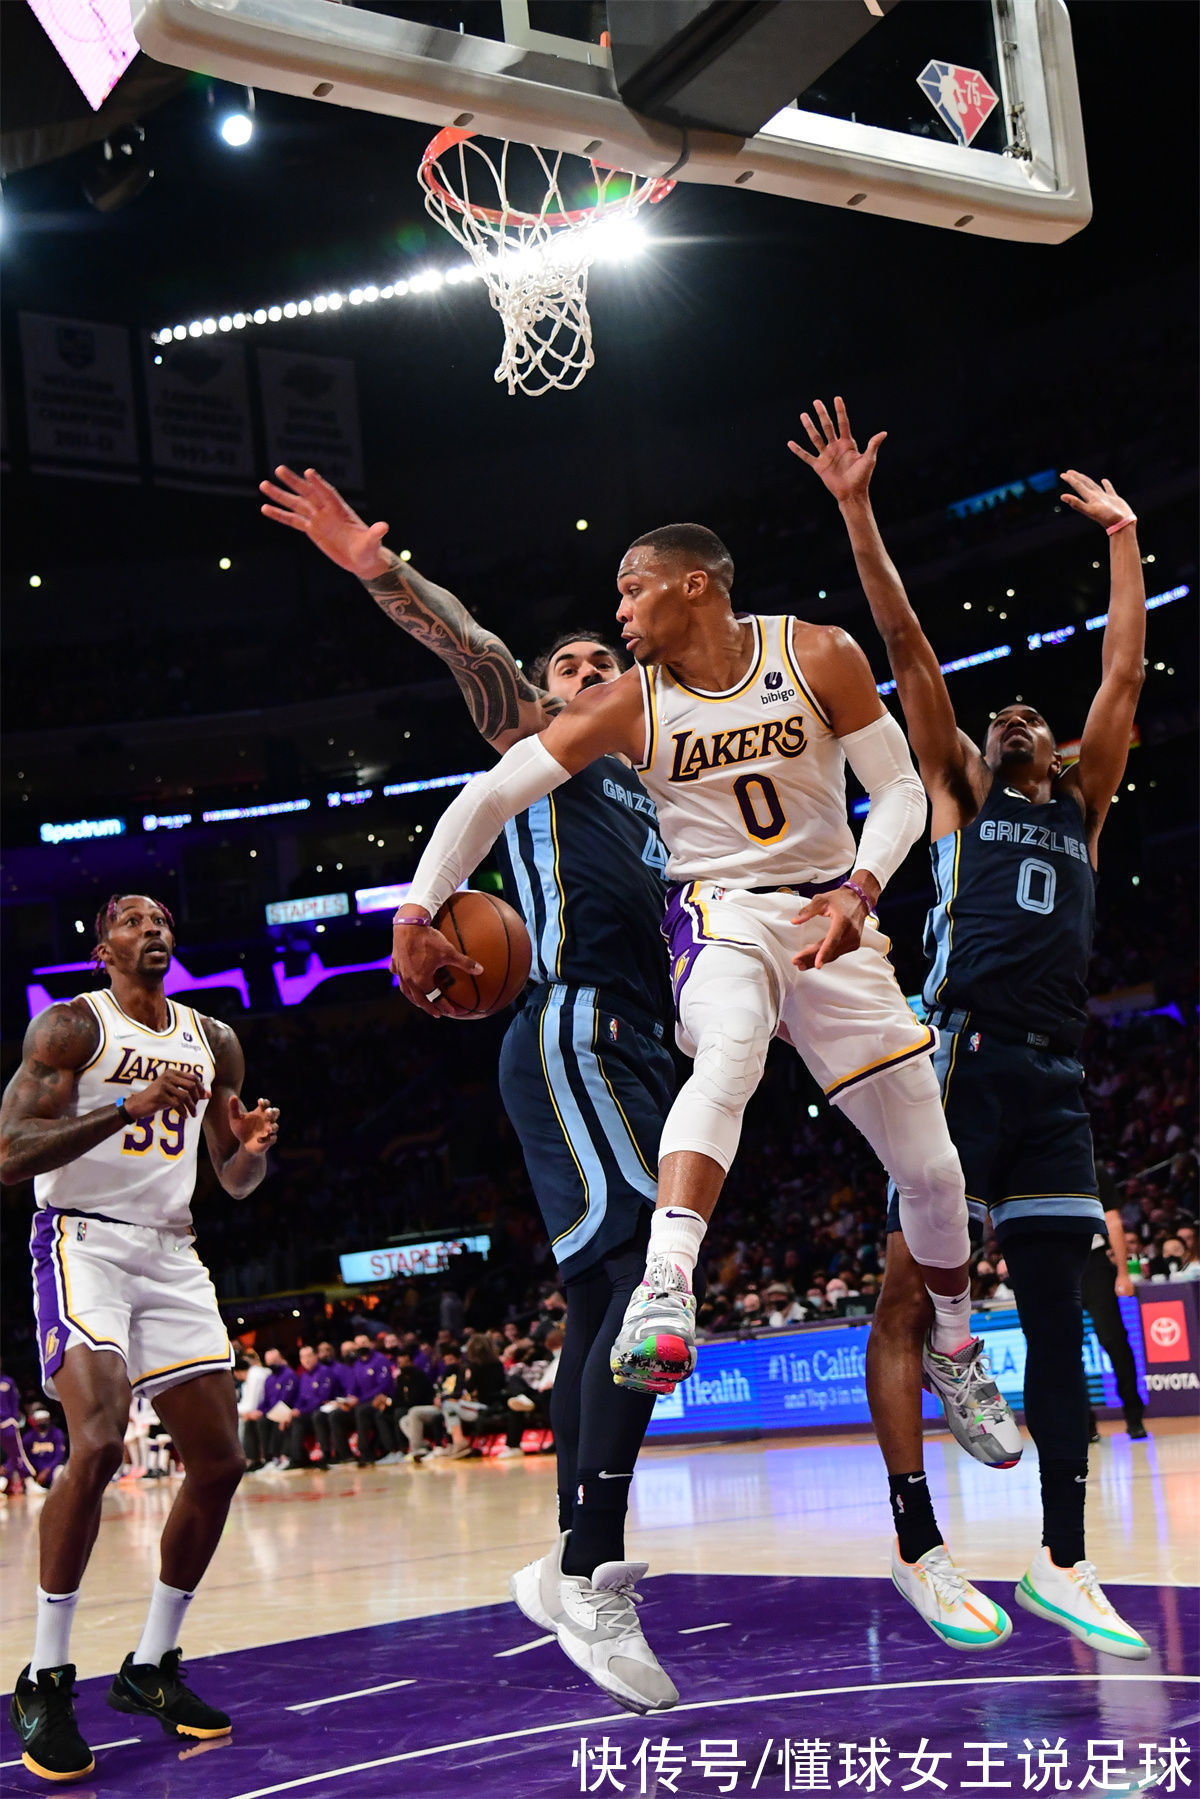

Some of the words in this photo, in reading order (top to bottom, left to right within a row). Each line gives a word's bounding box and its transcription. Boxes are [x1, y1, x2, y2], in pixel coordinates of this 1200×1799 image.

[760, 688, 795, 705] bibigo
[667, 715, 808, 783] LAKERS
[602, 778, 658, 823] GRIZZ
[731, 772, 790, 847] 0
[40, 819, 122, 844] Spectrum
[979, 820, 1089, 864] GRIZZLIES
[641, 827, 670, 882] 4
[1016, 857, 1057, 915] 0
[120, 1106, 186, 1161] 39
[685, 1367, 752, 1407] Health
[790, 1353, 811, 1384] in
[1143, 1372, 1200, 1392] TOYOTA
